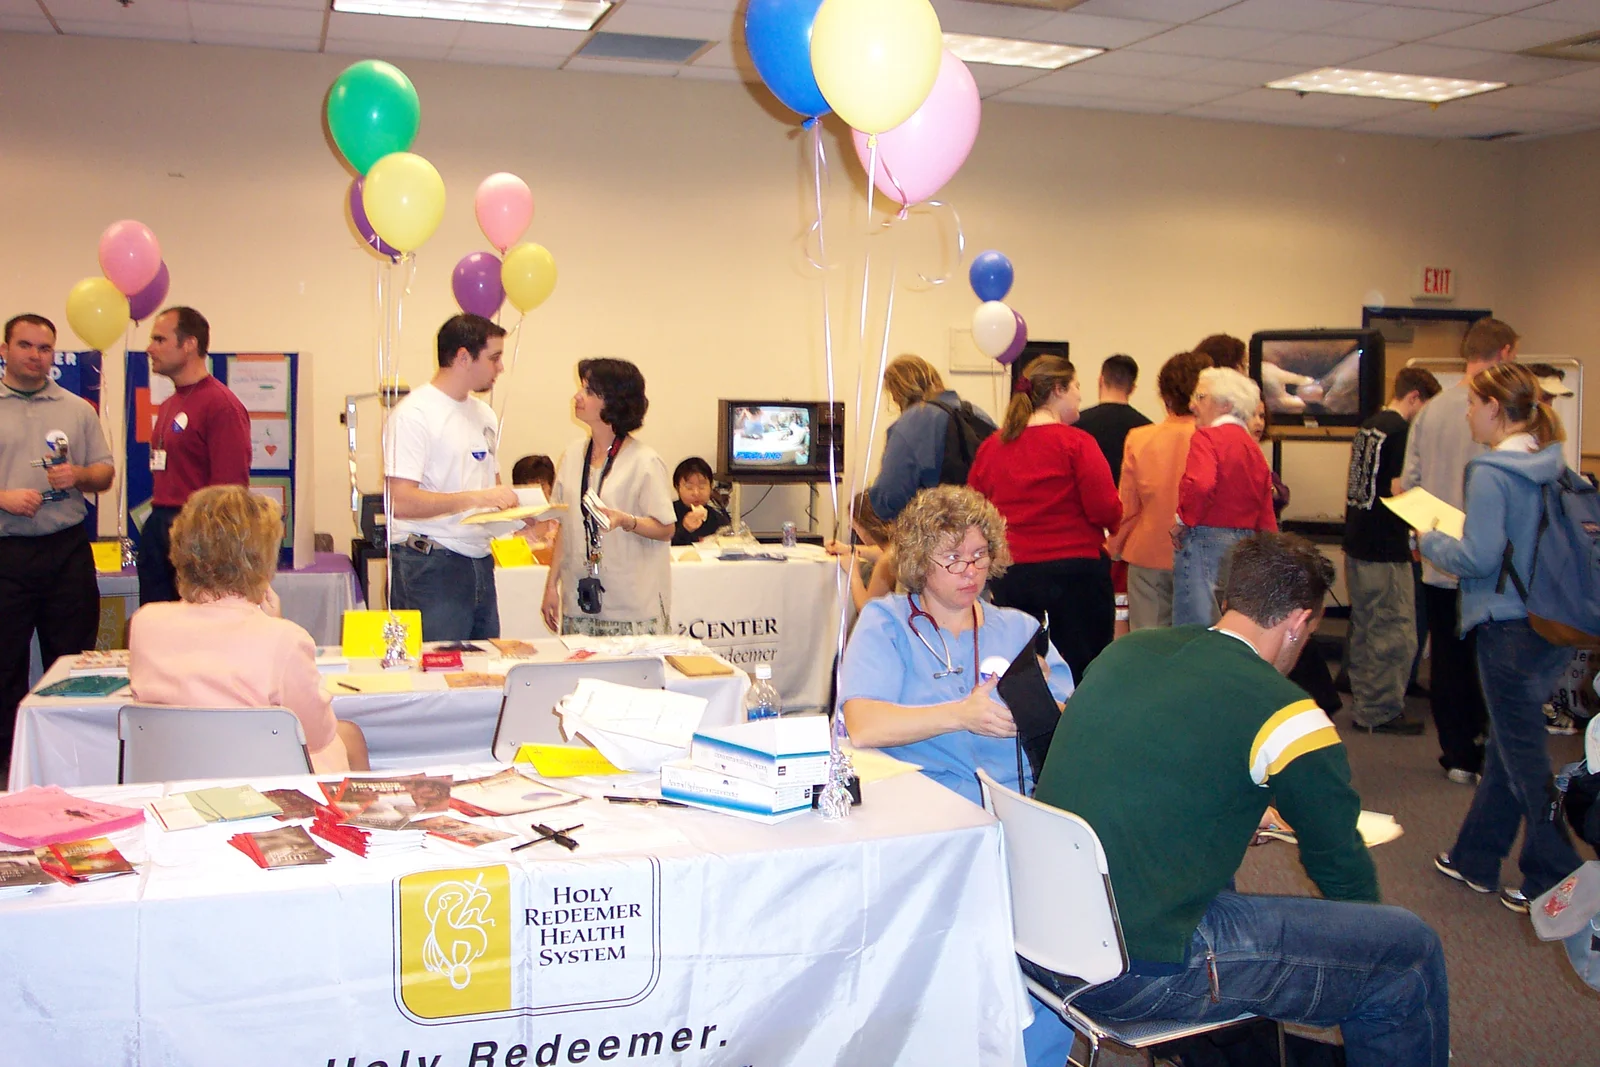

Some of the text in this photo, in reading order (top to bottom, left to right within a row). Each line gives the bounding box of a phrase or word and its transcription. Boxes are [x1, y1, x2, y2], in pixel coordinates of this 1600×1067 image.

[1424, 266, 1451, 294] EXIT
[720, 647, 778, 664] deemer
[553, 886, 613, 905] HOLY
[525, 903, 642, 926] REDEEMER
[540, 925, 625, 946] HEALTH
[539, 945, 626, 967] SYSTEM
[468, 1024, 728, 1067] Redeemer.
